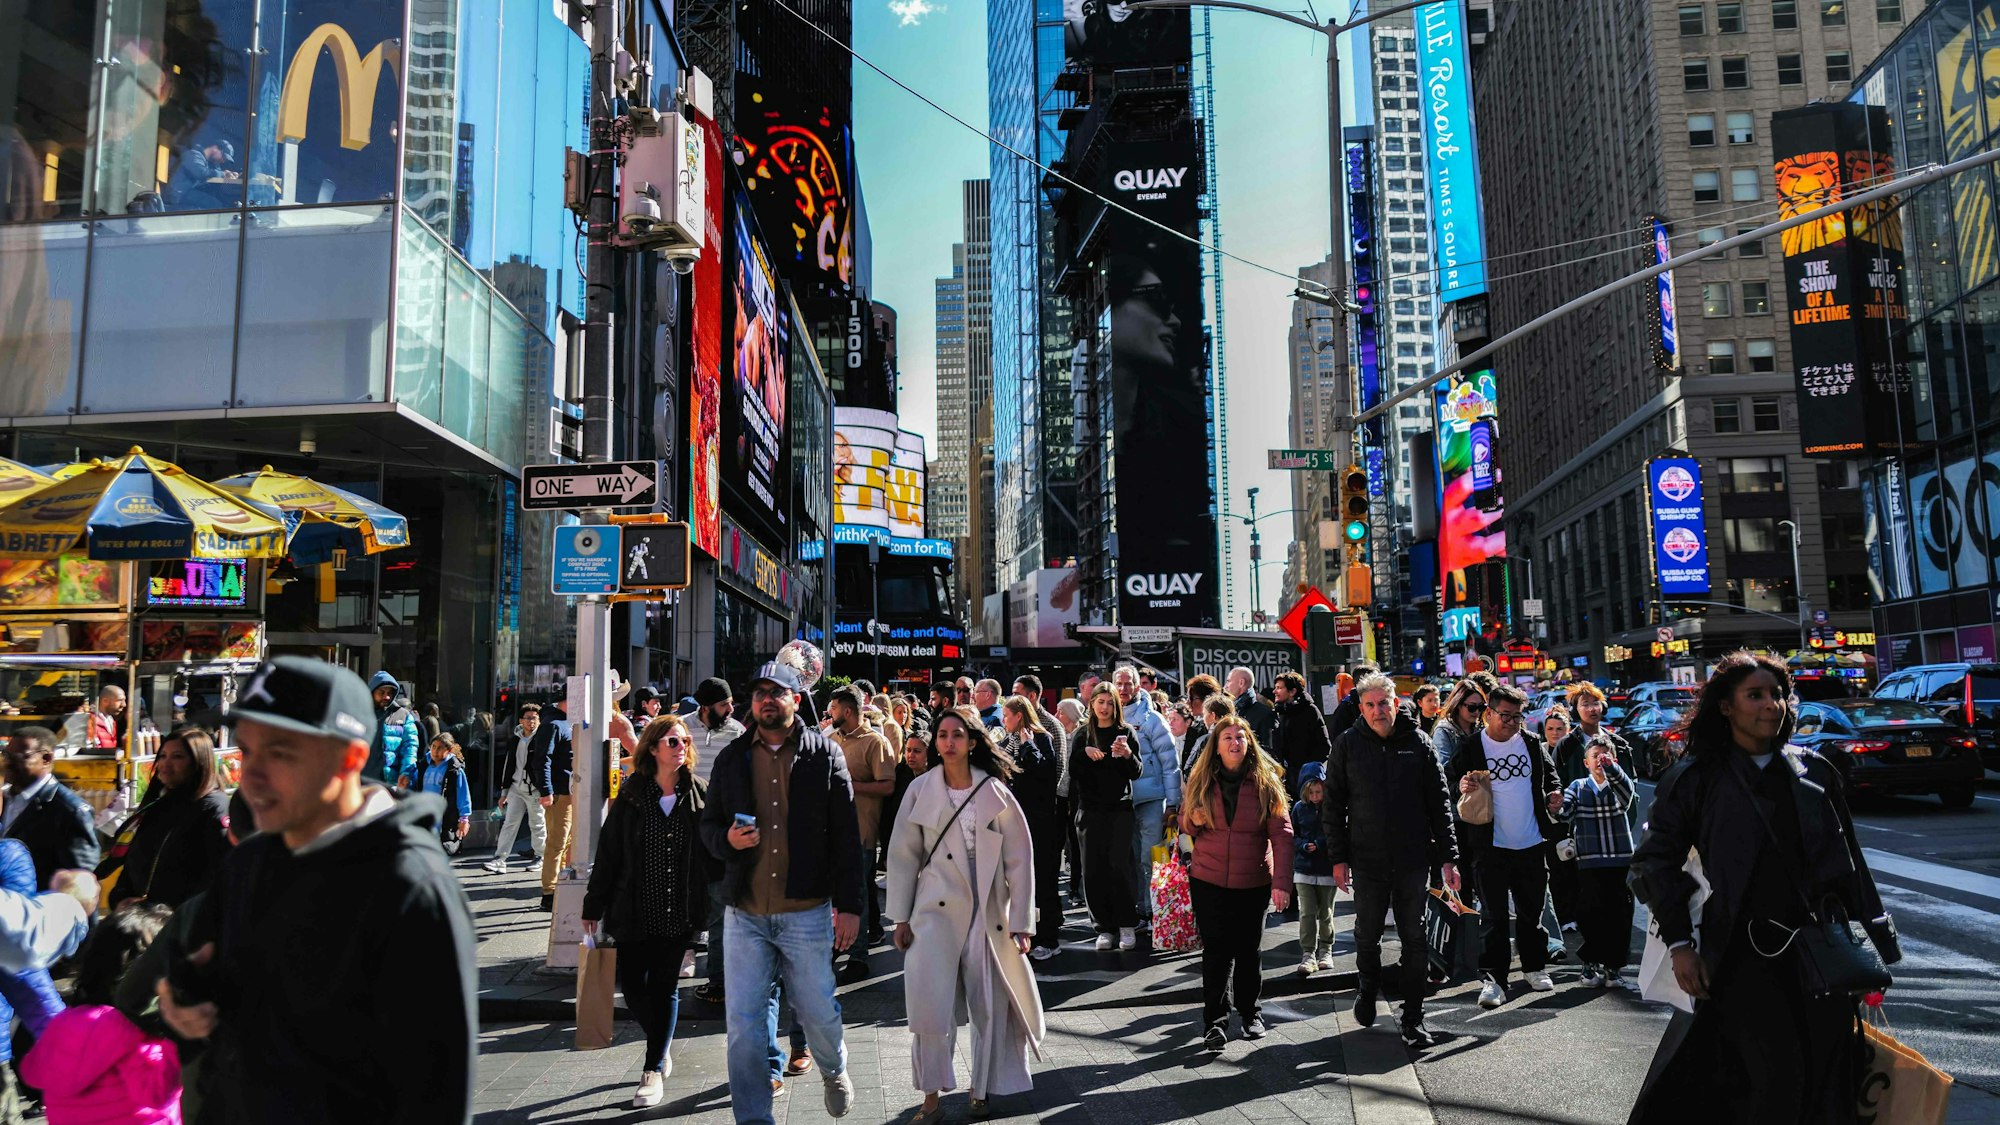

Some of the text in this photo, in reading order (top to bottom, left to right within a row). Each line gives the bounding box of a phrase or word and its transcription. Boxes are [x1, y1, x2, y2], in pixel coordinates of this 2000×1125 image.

[1429, 57, 1459, 160] Resort
[1114, 167, 1188, 191] QUAY
[1439, 167, 1459, 289] TIMES SQUARE
[1804, 260, 1830, 275] THE
[1800, 275, 1837, 293] SHOW
[1806, 291, 1835, 307] OF A
[1793, 304, 1850, 325] LIFETIME
[847, 300, 862, 368] 1500
[1801, 362, 1854, 377] チケットは
[1802, 373, 1856, 387] ここで入手
[1808, 384, 1850, 397] できます
[1805, 442, 1864, 454] LIONKING.COM
[1304, 452, 1318, 468] 45
[1324, 451, 1333, 463] St
[1473, 462, 1490, 471] TACO
[1475, 469, 1490, 478] BELL
[535, 475, 639, 495] ONE WAY
[1657, 506, 1701, 515] BUBBA GUMP
[1660, 513, 1686, 521] SHRIMP
[127, 539, 140, 548] ON
[141, 539, 149, 547] A
[151, 539, 172, 547] ROLL
[914, 540, 934, 554] for
[755, 548, 777, 600] GIFTS
[1126, 573, 1203, 596] QUAY
[1149, 600, 1181, 608] EYEWEAR
[1435, 585, 1445, 625] SQUARE
[913, 626, 934, 638] and
[911, 645, 937, 656] deal
[1193, 648, 1291, 665] DISCOVER
[1438, 636, 1447, 669] TIMES
